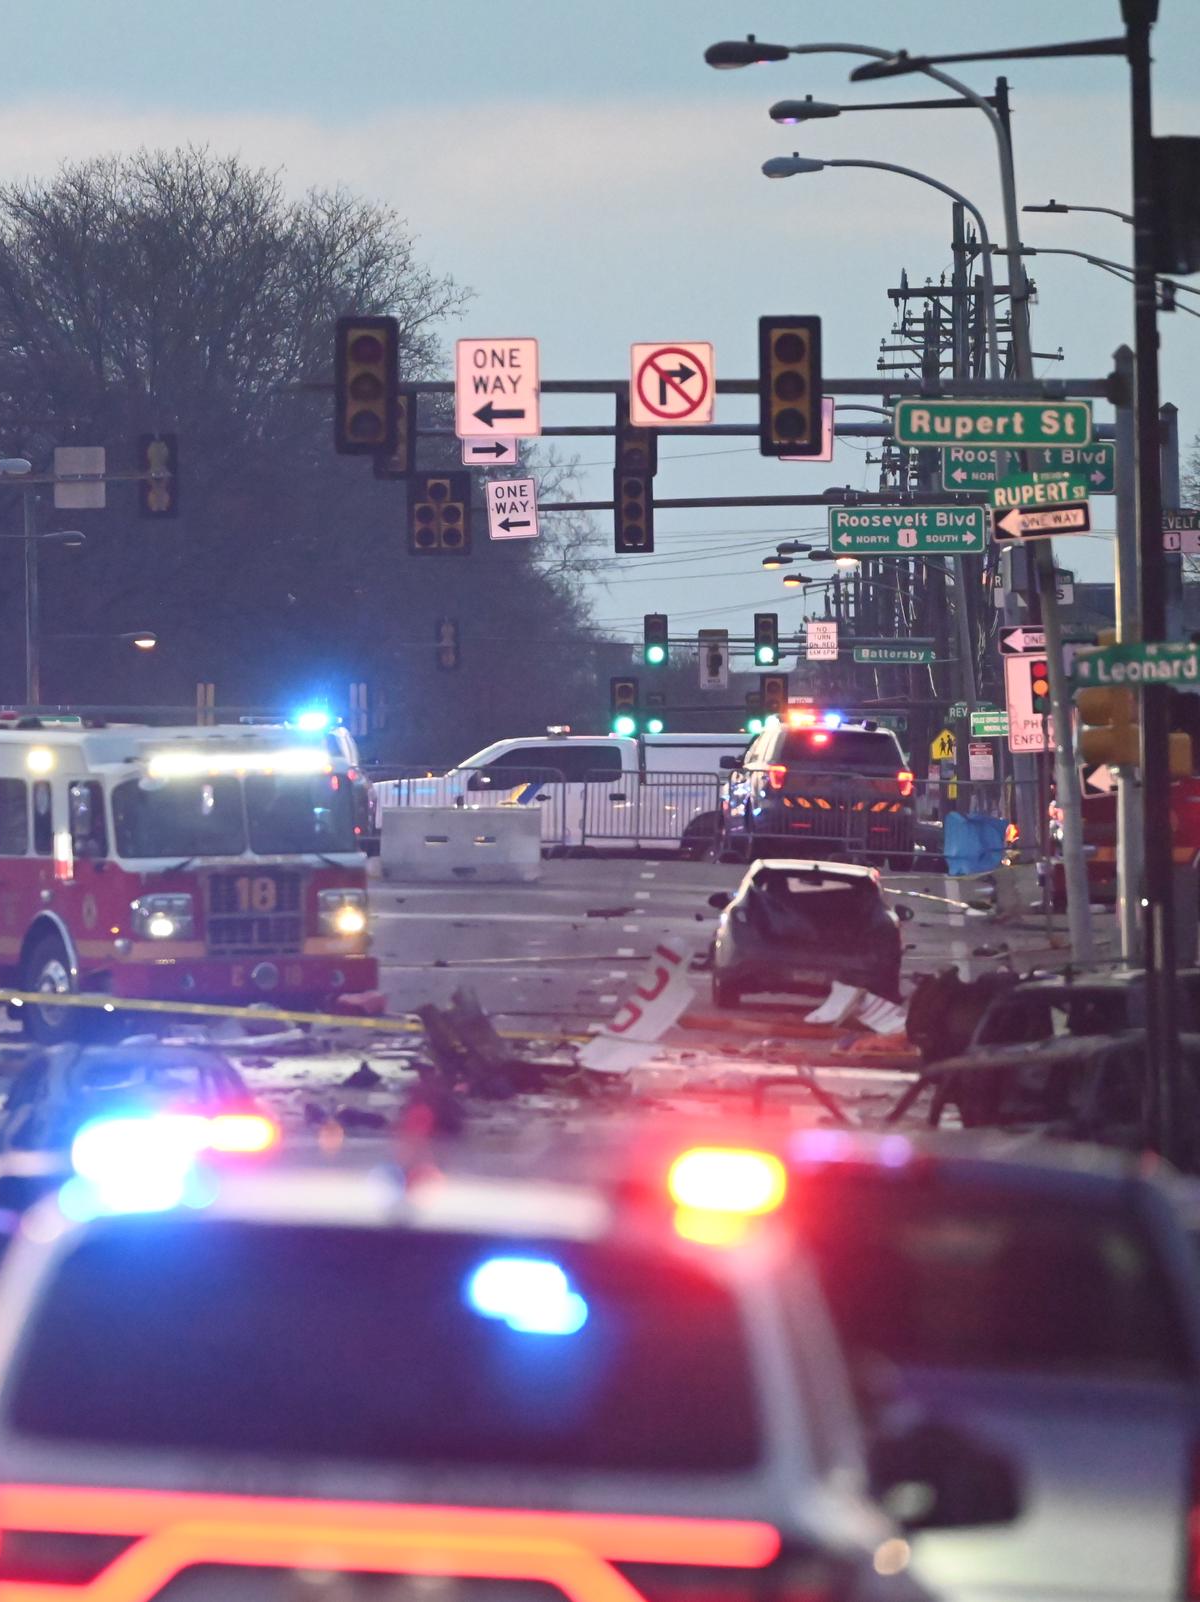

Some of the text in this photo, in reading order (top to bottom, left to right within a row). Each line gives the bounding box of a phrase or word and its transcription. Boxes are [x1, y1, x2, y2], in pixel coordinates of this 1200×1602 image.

[473, 348, 521, 369] ONE
[473, 375, 522, 395] WAY
[910, 410, 1076, 438] Rupert St
[1061, 449, 1106, 464] Blvd
[495, 485, 528, 499] ONE
[994, 482, 1086, 506] RUPERT ST
[495, 501, 529, 514] WAY
[837, 512, 976, 527] Roosevelt Blvd
[1052, 512, 1078, 524] WAY
[856, 532, 958, 543] NORTH 1 SOUTH
[861, 648, 924, 661] Battersby
[1098, 653, 1198, 681] Leonard
